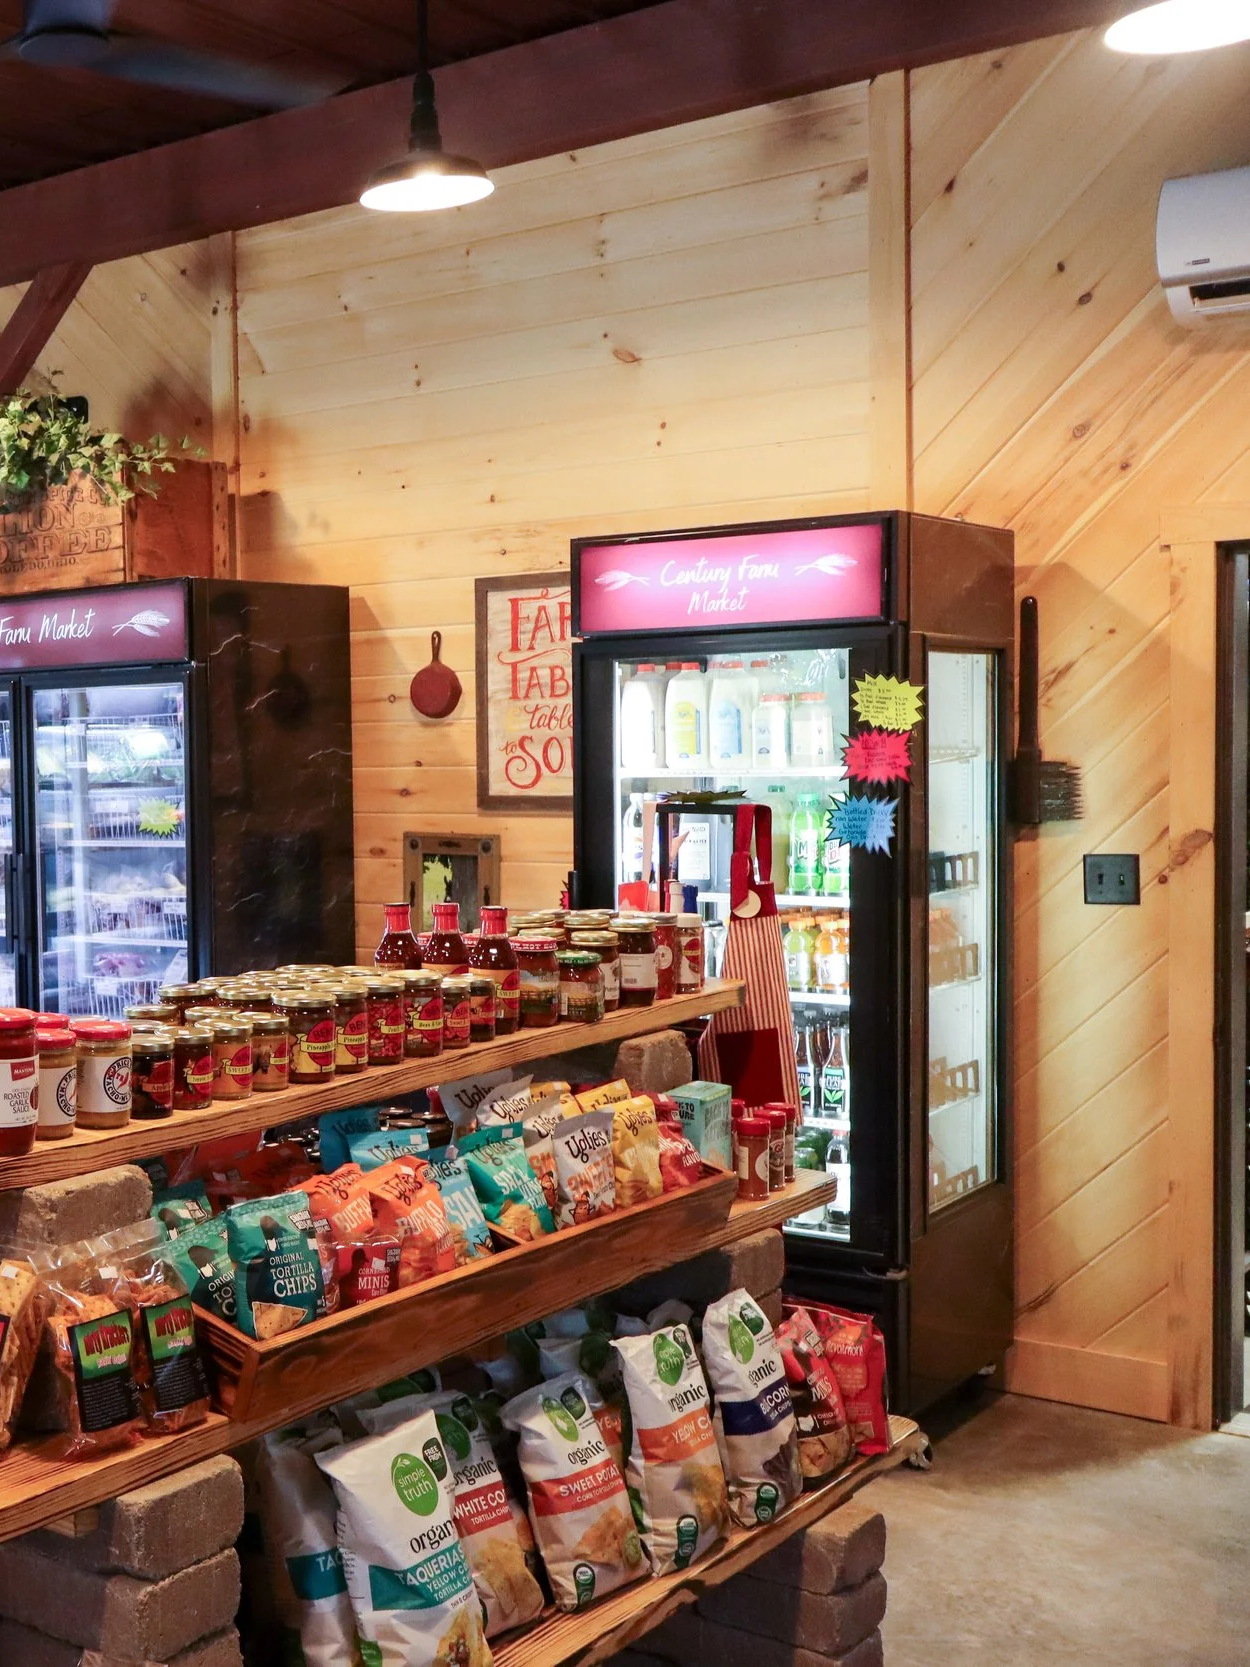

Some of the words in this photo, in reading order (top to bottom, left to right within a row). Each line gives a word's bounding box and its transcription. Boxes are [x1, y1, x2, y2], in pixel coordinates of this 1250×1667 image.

[660, 556, 730, 593] Century
[687, 587, 749, 616] Market
[39, 608, 96, 643] Market
[3, 1091, 30, 1101] ROASTED
[469, 1135, 517, 1167] Uglies
[564, 1127, 608, 1164] Uglies
[269, 1252, 304, 1266] ORIGINAL
[270, 1262, 315, 1280] TORTILLA
[274, 1273, 318, 1298] CHIPS
[358, 1274, 391, 1291] MINIS
[423, 1445, 440, 1456] FREE
[427, 1451, 443, 1463] FROM
[567, 1439, 606, 1467] organic
[397, 1467, 427, 1489] simple
[454, 1456, 498, 1486] organic
[403, 1479, 434, 1503] truth
[558, 1474, 596, 1498] SWEET
[576, 1491, 594, 1504] CORN
[453, 1497, 487, 1521] WHITE
[470, 1512, 497, 1527] TORTILLA
[394, 1543, 466, 1588] TAQUERIAS
[426, 1567, 458, 1595] YELLOW
[433, 1580, 463, 1602] TORTILLA
